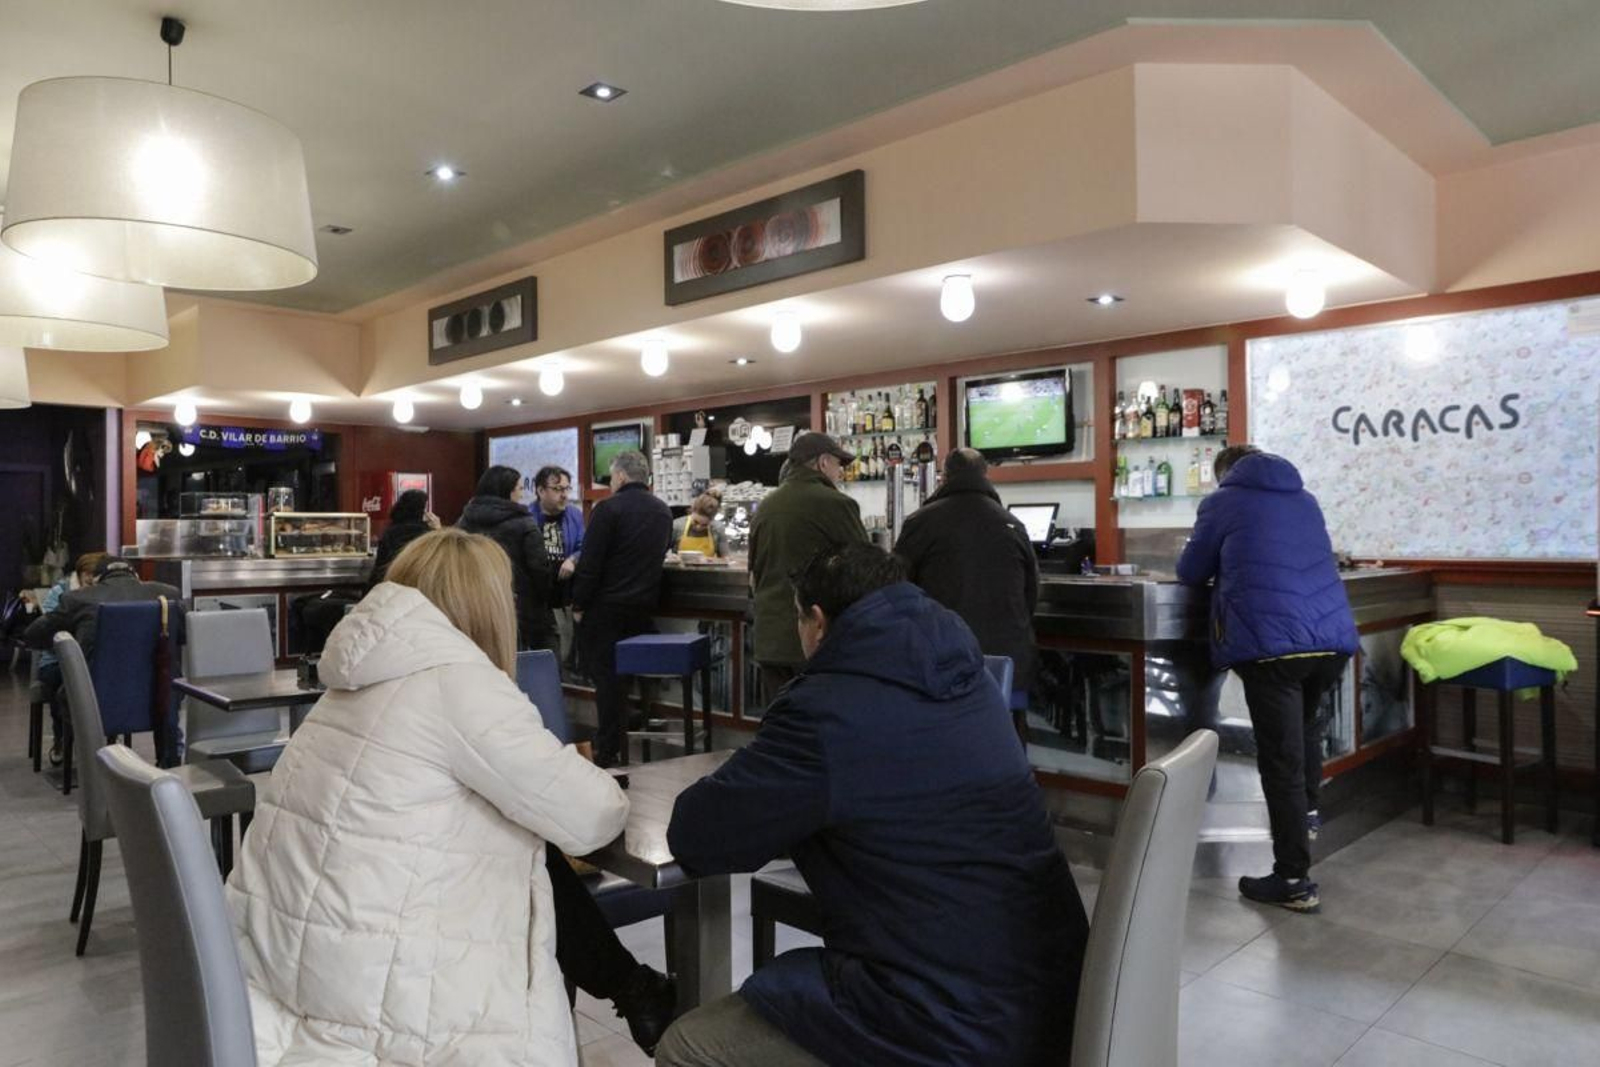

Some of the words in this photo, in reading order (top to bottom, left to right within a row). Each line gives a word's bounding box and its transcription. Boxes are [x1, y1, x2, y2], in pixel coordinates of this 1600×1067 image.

[1331, 392, 1521, 446] CARACAS
[221, 432, 253, 443] VILAR
[255, 434, 268, 443] DE
[269, 434, 307, 444] BARRIO
